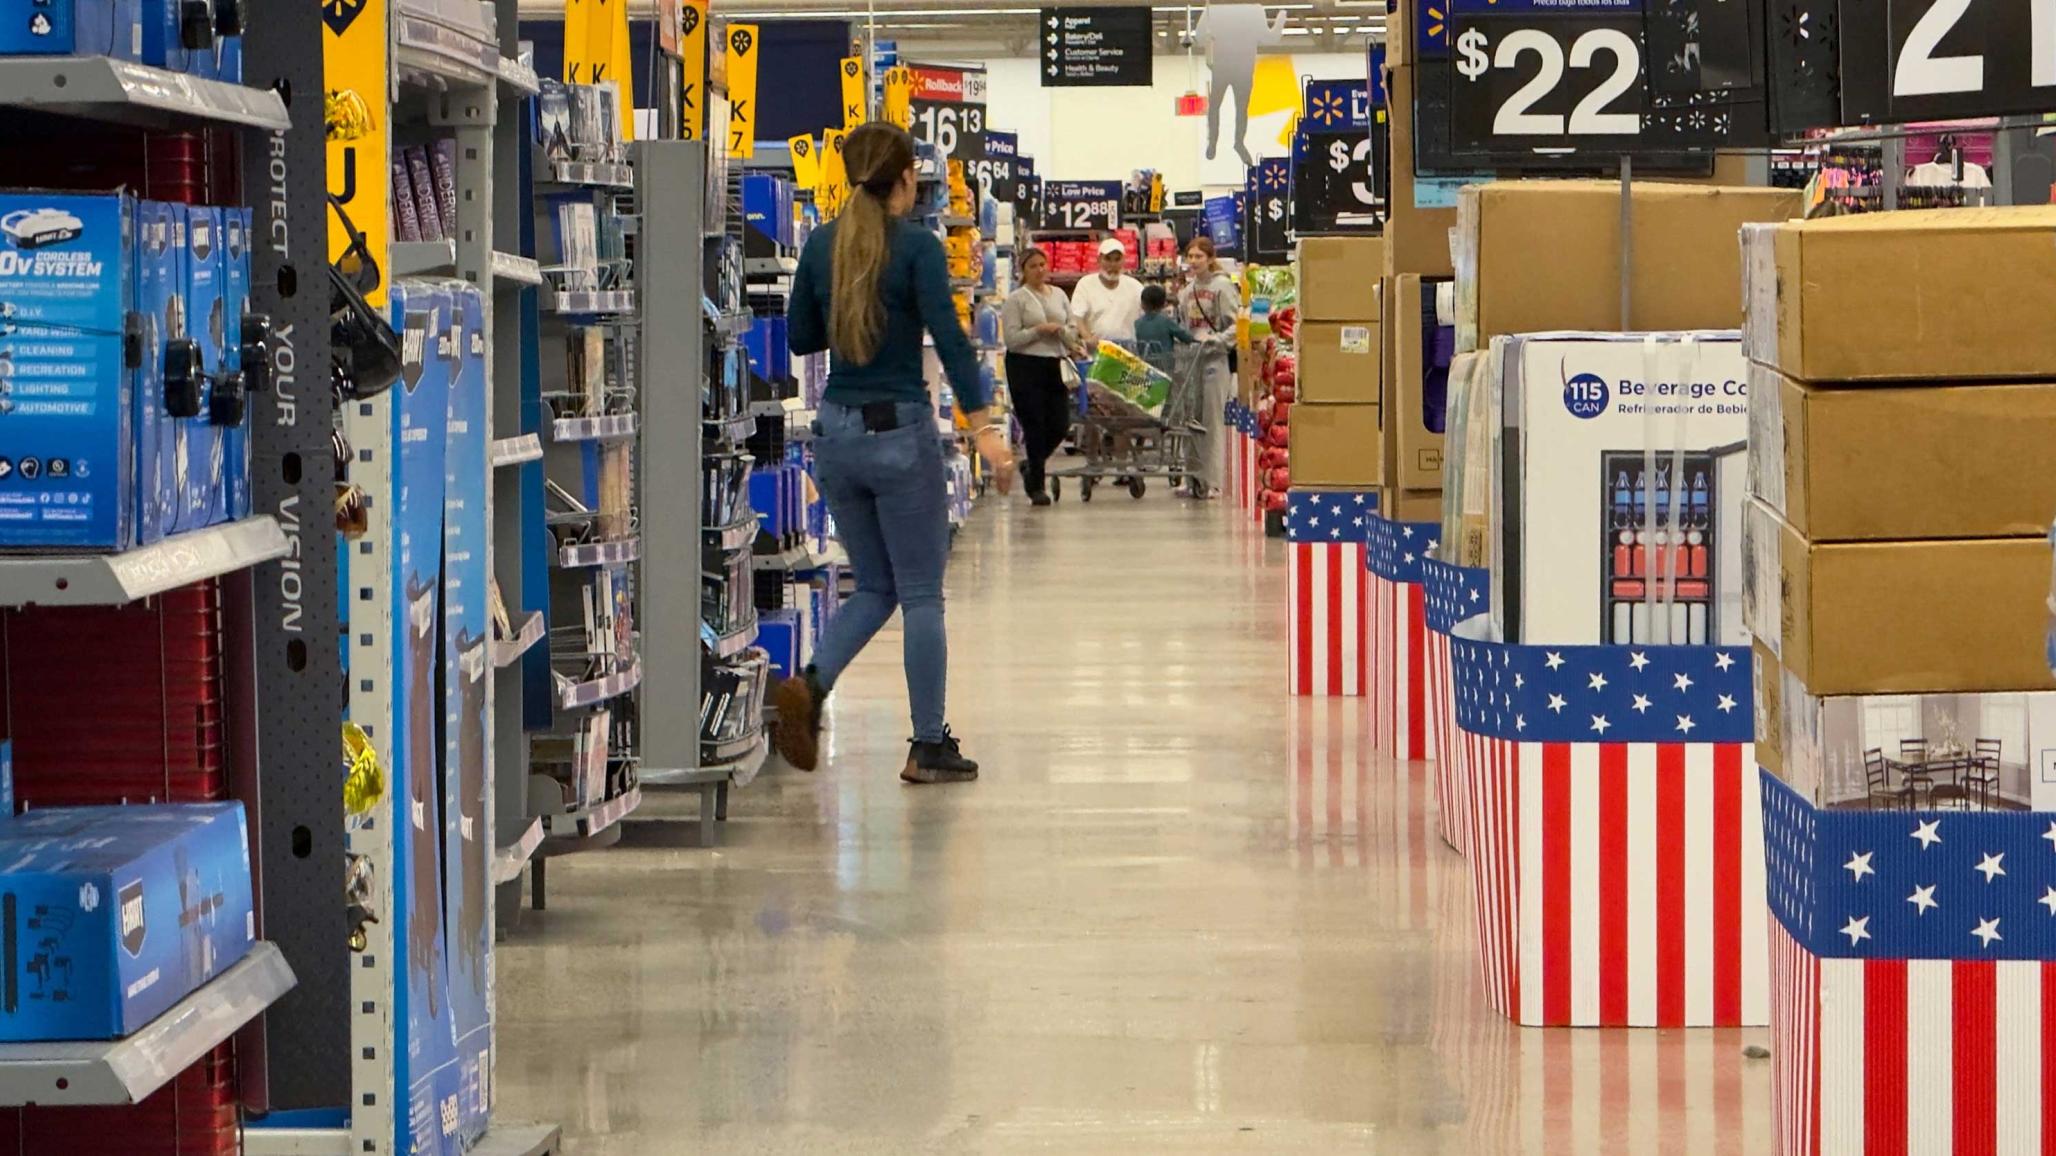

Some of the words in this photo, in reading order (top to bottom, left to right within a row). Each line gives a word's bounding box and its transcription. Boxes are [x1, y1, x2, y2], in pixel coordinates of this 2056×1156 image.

[1065, 16, 1091, 26] Apparel
[1065, 47, 1097, 56] Customer
[1098, 47, 1124, 56] Service
[1065, 64, 1088, 72] Health
[1095, 64, 1119, 74] Beauty
[925, 79, 962, 94] Rollback
[1456, 27, 1640, 135] $22
[731, 100, 747, 122] K
[848, 105, 859, 118] K
[732, 131, 743, 151] 7
[991, 141, 1014, 154] Price
[1062, 187, 1080, 196] Low
[1082, 187, 1105, 197] Price
[1268, 197, 1284, 222] $
[35, 251, 92, 261] CORDLESS
[34, 262, 102, 276] SYSTEM
[20, 345, 74, 356] CLEANING
[20, 365, 86, 376] RECREATION
[275, 324, 296, 427] YOUR
[20, 384, 69, 395] LIGHTING
[1570, 382, 1603, 401] 115
[1619, 380, 1716, 399] Beverage
[20, 402, 89, 413] AUTOMOTIVE
[1573, 402, 1600, 413] CAN
[1698, 403, 1713, 414] de
[280, 496, 302, 632] VISION
